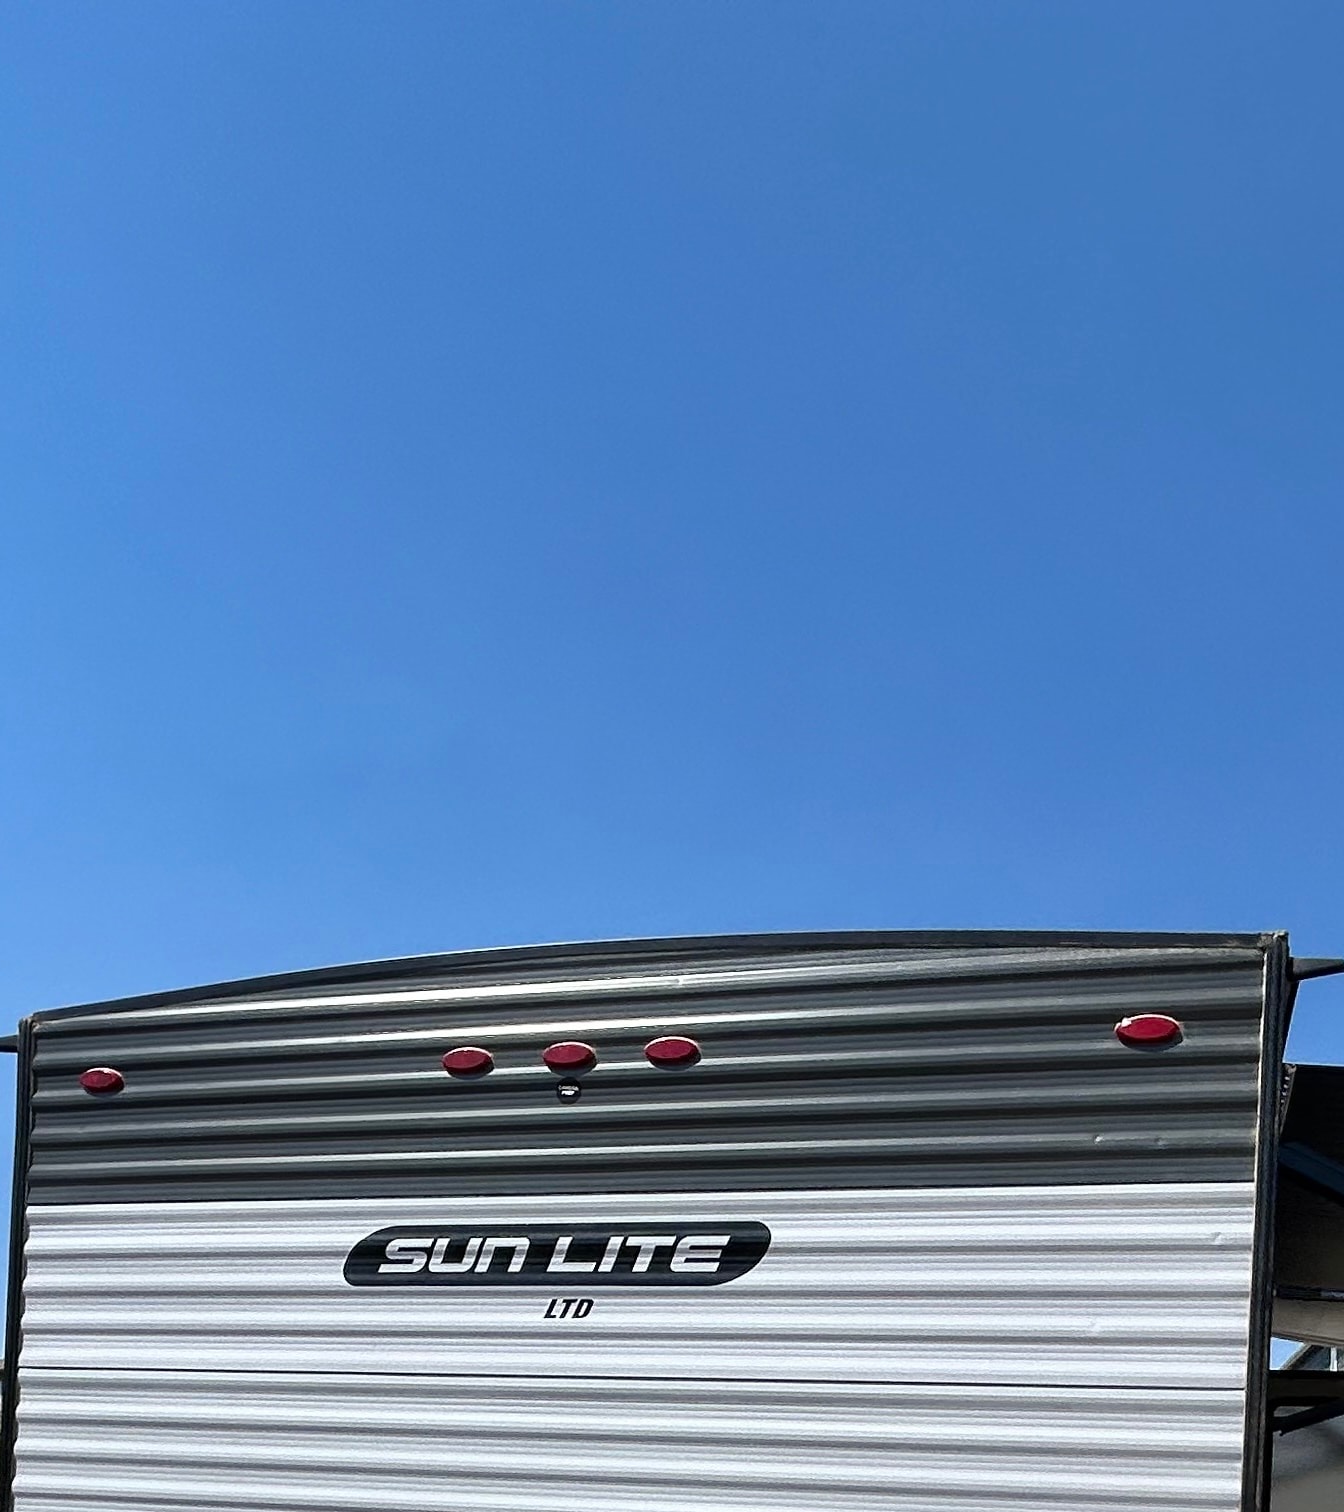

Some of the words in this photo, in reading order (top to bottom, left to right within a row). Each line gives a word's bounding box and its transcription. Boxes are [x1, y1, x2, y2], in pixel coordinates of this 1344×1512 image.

[377, 1236, 531, 1274] SUN
[545, 1234, 731, 1273] LITE
[544, 1298, 594, 1319] LTD
